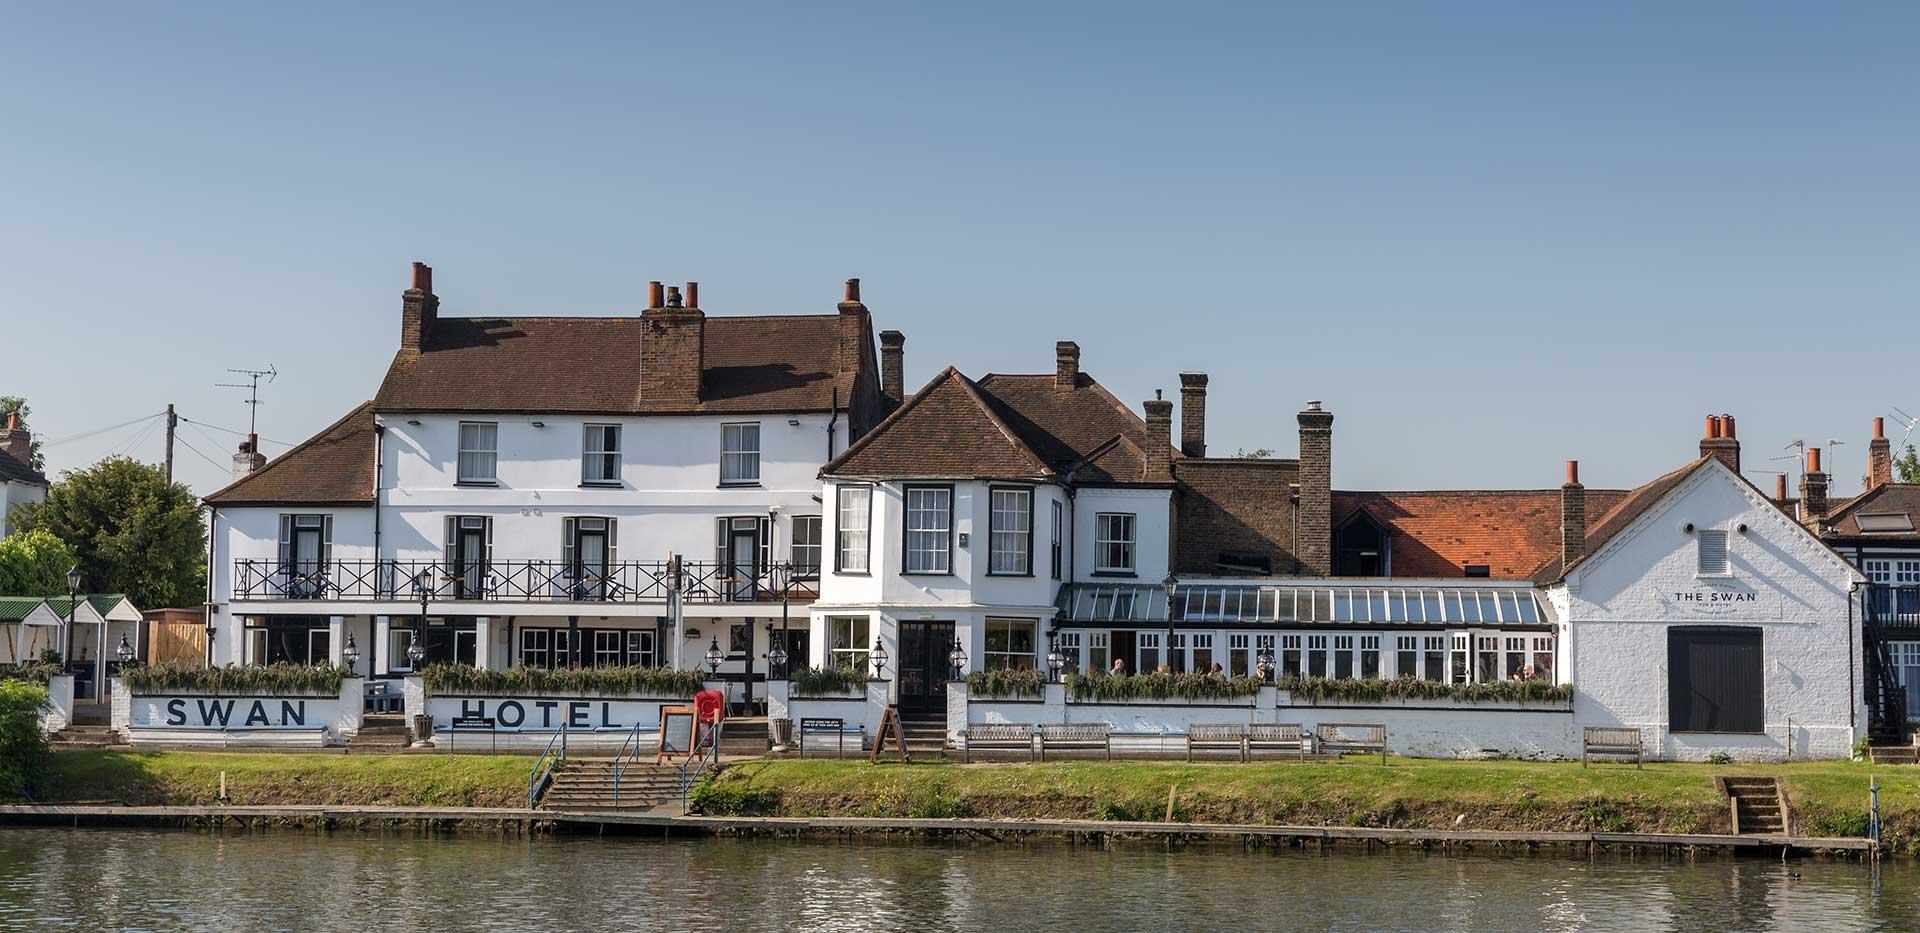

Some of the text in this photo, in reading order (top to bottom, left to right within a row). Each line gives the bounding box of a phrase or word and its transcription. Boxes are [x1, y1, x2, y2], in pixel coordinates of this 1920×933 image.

[1675, 592, 1755, 601] THE SWAN
[166, 699, 305, 726] SWAN
[462, 700, 622, 728] HOTEL
